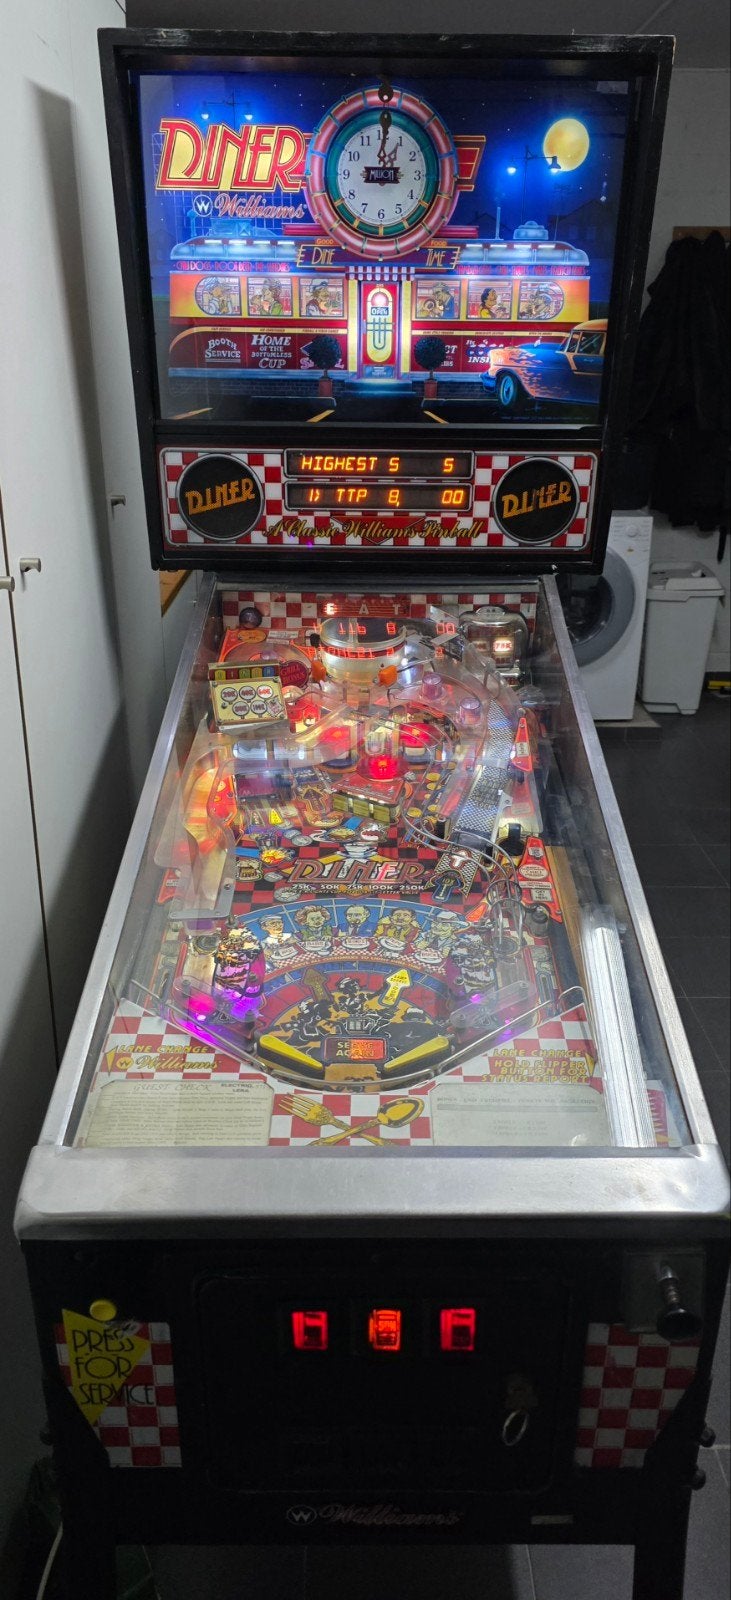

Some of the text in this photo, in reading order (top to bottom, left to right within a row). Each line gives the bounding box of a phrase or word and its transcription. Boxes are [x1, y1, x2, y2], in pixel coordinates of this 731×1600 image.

[360, 135, 371, 147] 11
[156, 118, 306, 192] DINER
[349, 151, 360, 162] 10
[409, 151, 417, 162] 2
[343, 170, 350, 180] 9
[369, 170, 395, 180] MILLION
[414, 170, 422, 181] 3
[348, 189, 356, 199] 8
[407, 189, 414, 199] 4
[214, 193, 305, 218] Williams
[361, 203, 369, 213] 7
[395, 204, 402, 215] 5
[378, 209, 385, 220] 6
[312, 247, 336, 265] DINE
[426, 250, 446, 267] TIME
[208, 337, 237, 351] BOOTH
[251, 334, 291, 346] HOME
[205, 350, 241, 359] SERVICE
[258, 358, 286, 370] CUP
[301, 456, 378, 472] HIGHEST
[185, 478, 256, 516] DINER
[337, 488, 368, 503] TTP
[442, 490, 464, 504] 00
[262, 519, 484, 539] A Classic Williams Pinball
[289, 860, 425, 883] DINER
[120, 1045, 208, 1054] LANE CHANGE
[337, 1041, 374, 1049] SERVE
[336, 1049, 375, 1057] AGAIN
[493, 1049, 582, 1058] LANE CHANGE
[136, 1054, 218, 1071] Williams
[534, 1060, 586, 1069] FLIPPER
[500, 1067, 587, 1076] BUTTON FOR
[481, 1074, 588, 1083] STATUS REPORT
[175, 1083, 213, 1092] CHECK
[75, 1356, 132, 1380] FOR
[79, 1383, 154, 1406] SERVICE
[319, 1503, 460, 1526] Williams
